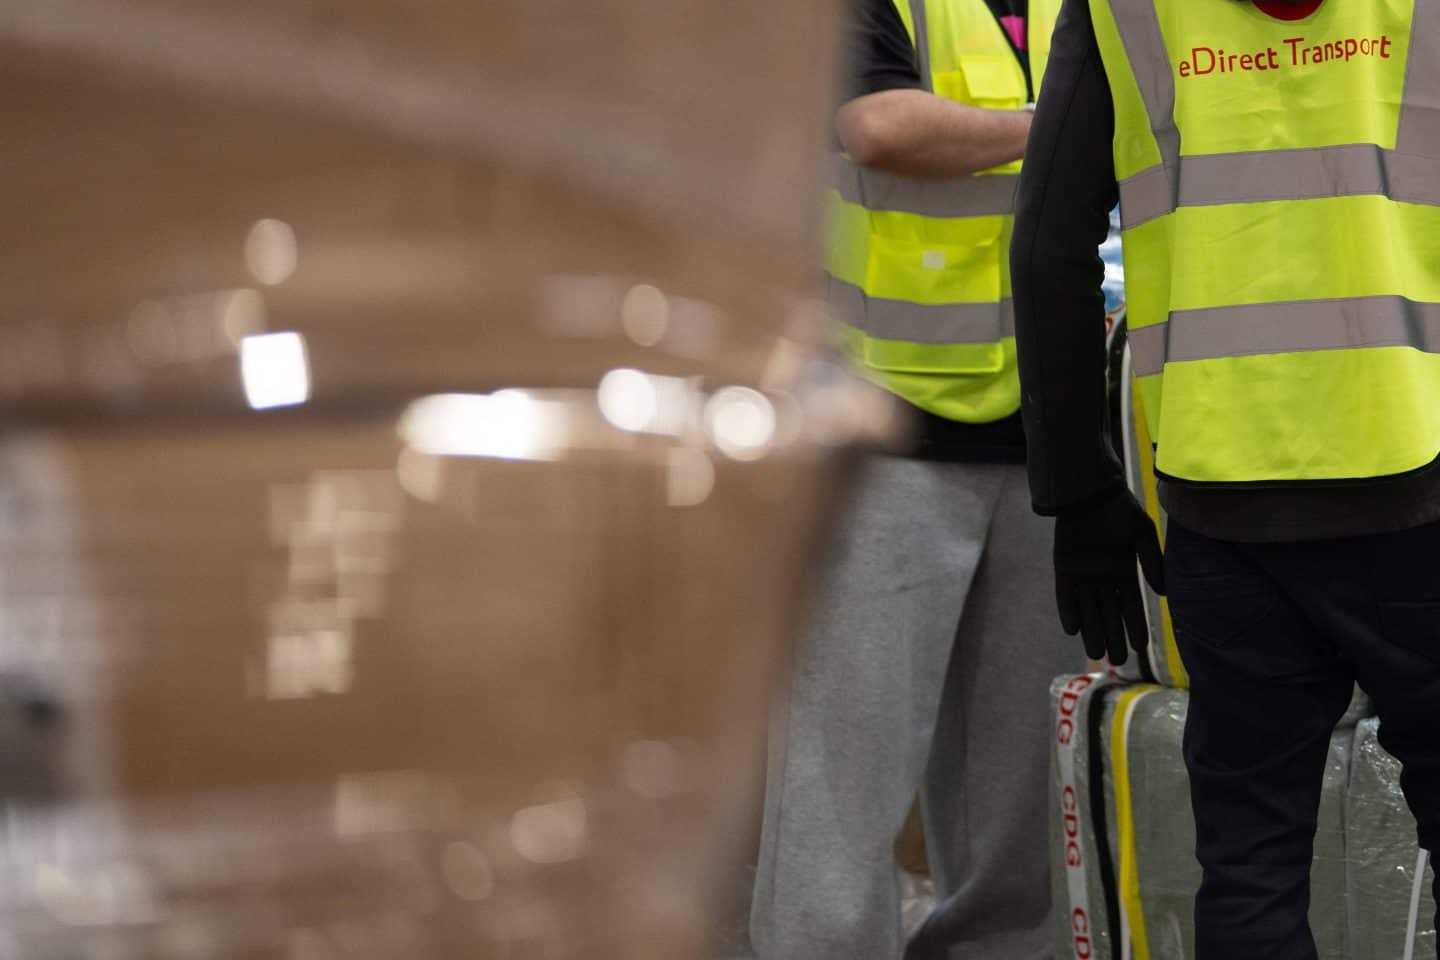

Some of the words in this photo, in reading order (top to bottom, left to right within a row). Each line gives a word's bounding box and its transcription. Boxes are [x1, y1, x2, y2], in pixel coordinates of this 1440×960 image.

[1178, 47, 1279, 77] eDirect
[1282, 35, 1392, 66] Transport
[1057, 674, 1093, 745] CDG
[1062, 785, 1081, 868] CDG
[1071, 907, 1091, 960] CD
